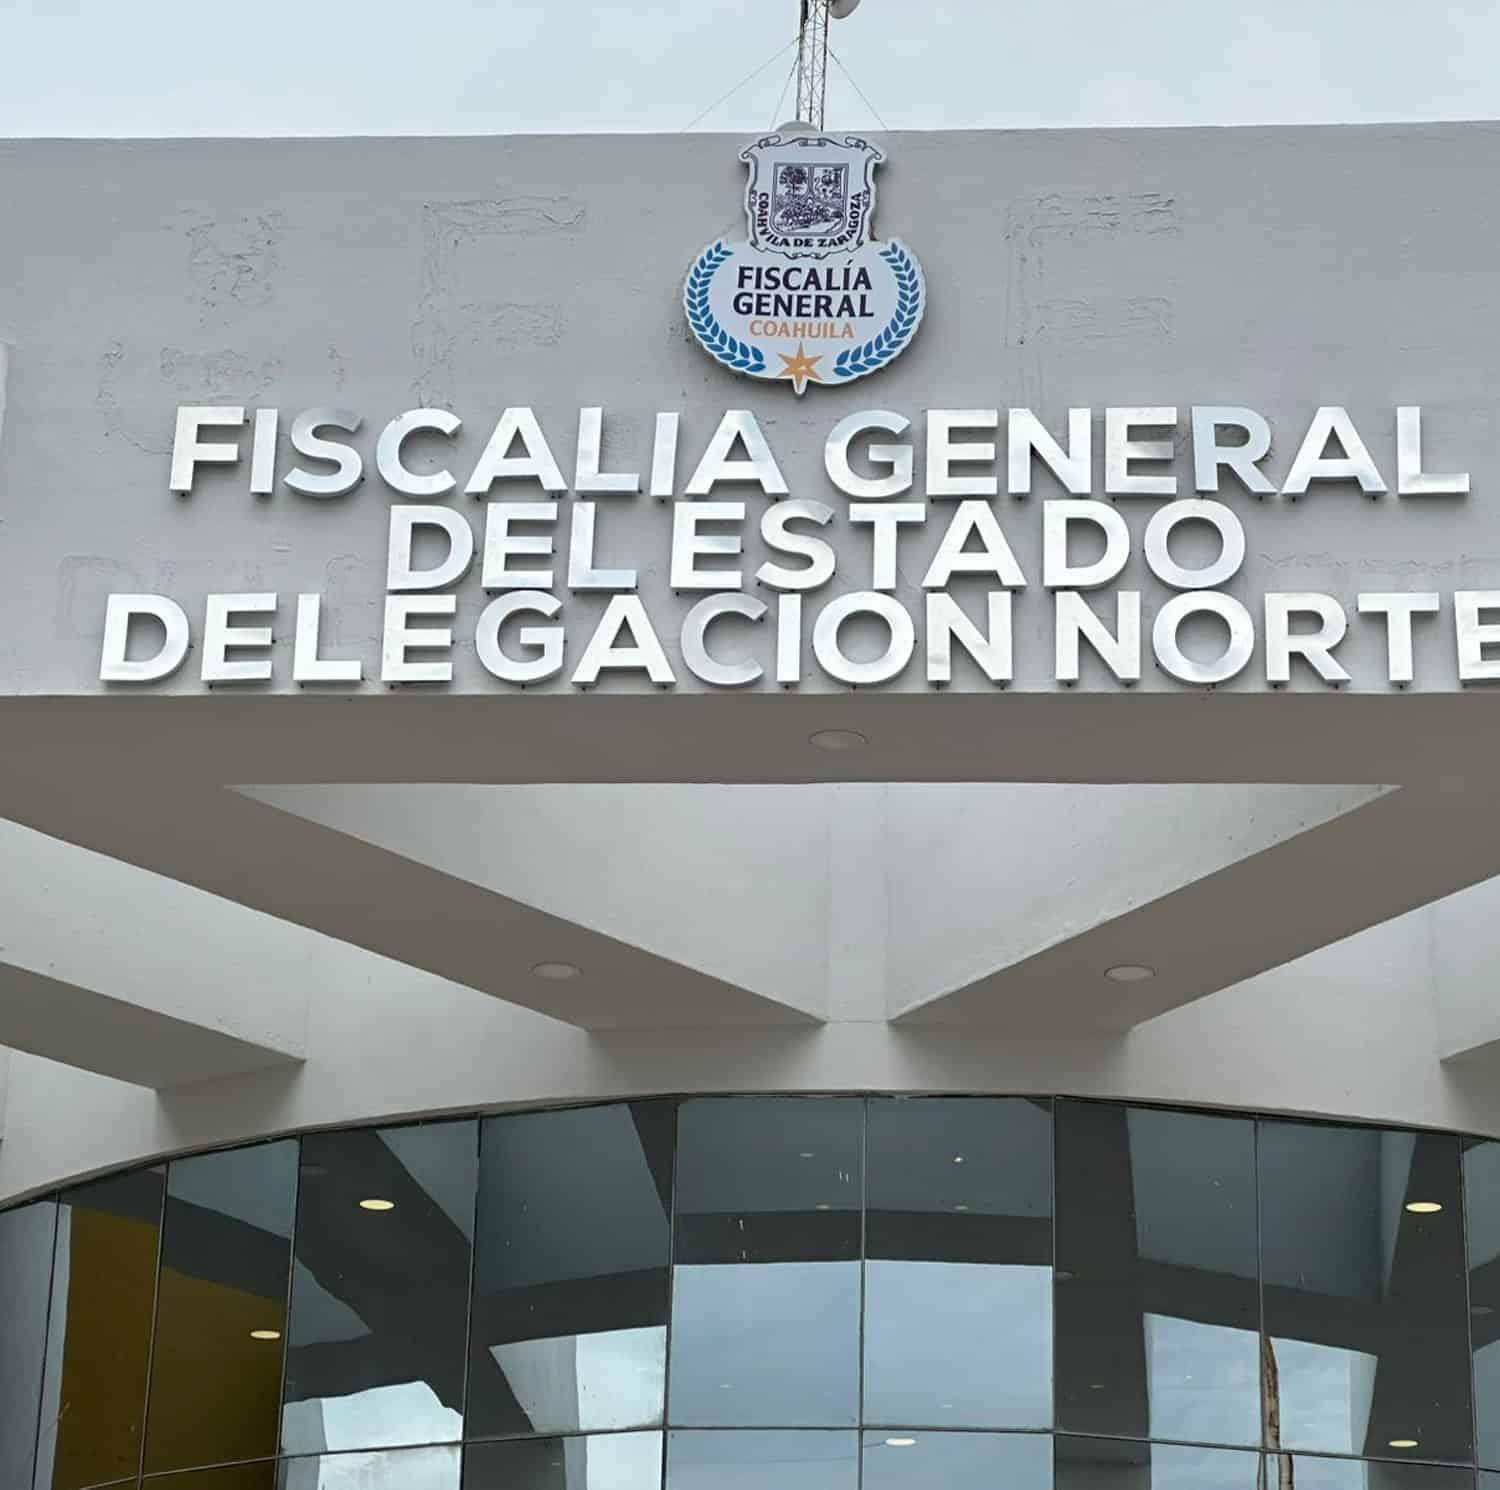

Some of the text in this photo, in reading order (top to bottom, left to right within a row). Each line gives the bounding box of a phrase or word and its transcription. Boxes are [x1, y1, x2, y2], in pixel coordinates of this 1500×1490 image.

[794, 239, 813, 247] DE
[818, 192, 861, 247] ZARAGOZA
[738, 259, 872, 290] FISCALÍA
[733, 292, 874, 317] GENERAL
[750, 320, 854, 338] COAHUILA
[169, 405, 1471, 498] FISCALIA GENERAL
[387, 499, 1246, 592] DEL ESTADO
[100, 590, 1014, 685] DELEGACION
